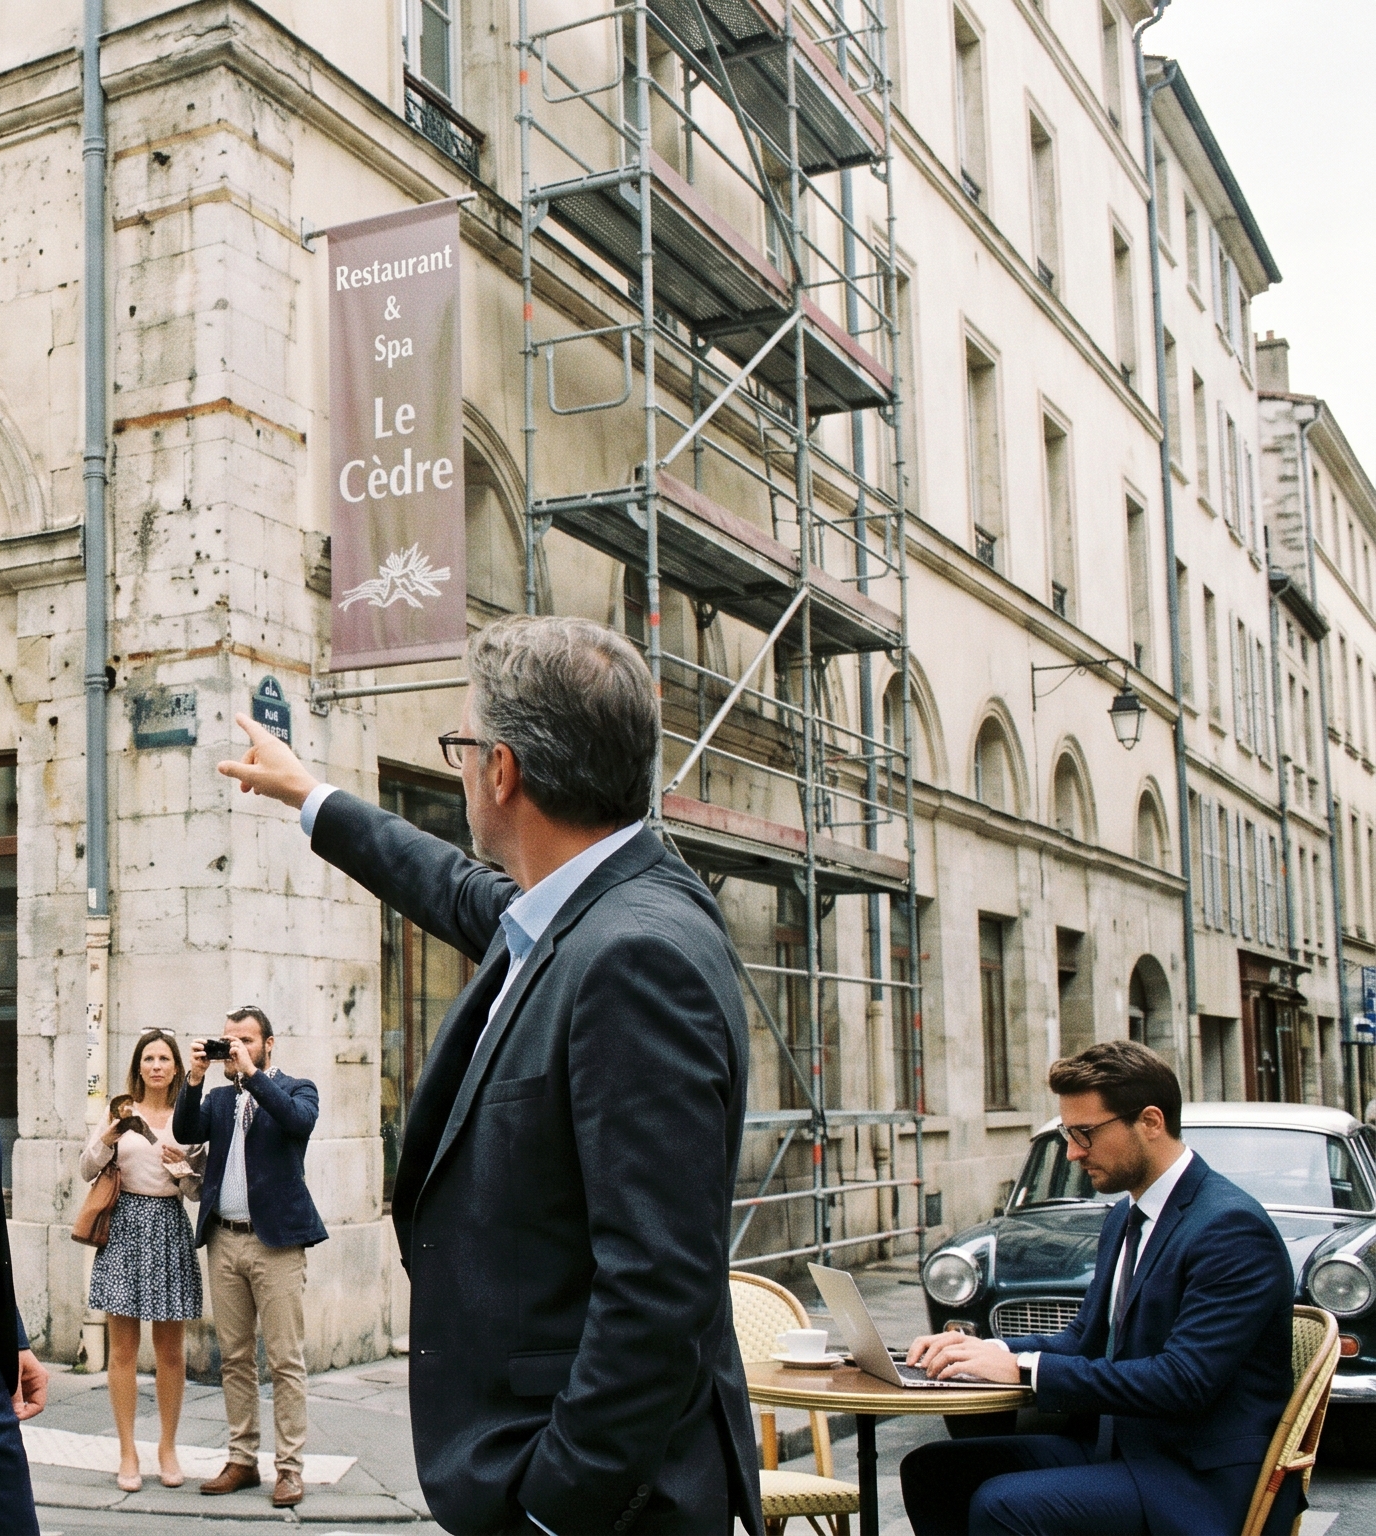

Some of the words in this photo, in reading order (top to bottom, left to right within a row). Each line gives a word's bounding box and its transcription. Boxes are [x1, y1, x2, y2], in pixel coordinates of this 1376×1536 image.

[336, 244, 453, 291] Restaurant
[384, 295, 401, 320] &
[374, 334, 413, 368] Spa
[374, 397, 416, 439] Le
[339, 448, 454, 504] Cèdre
